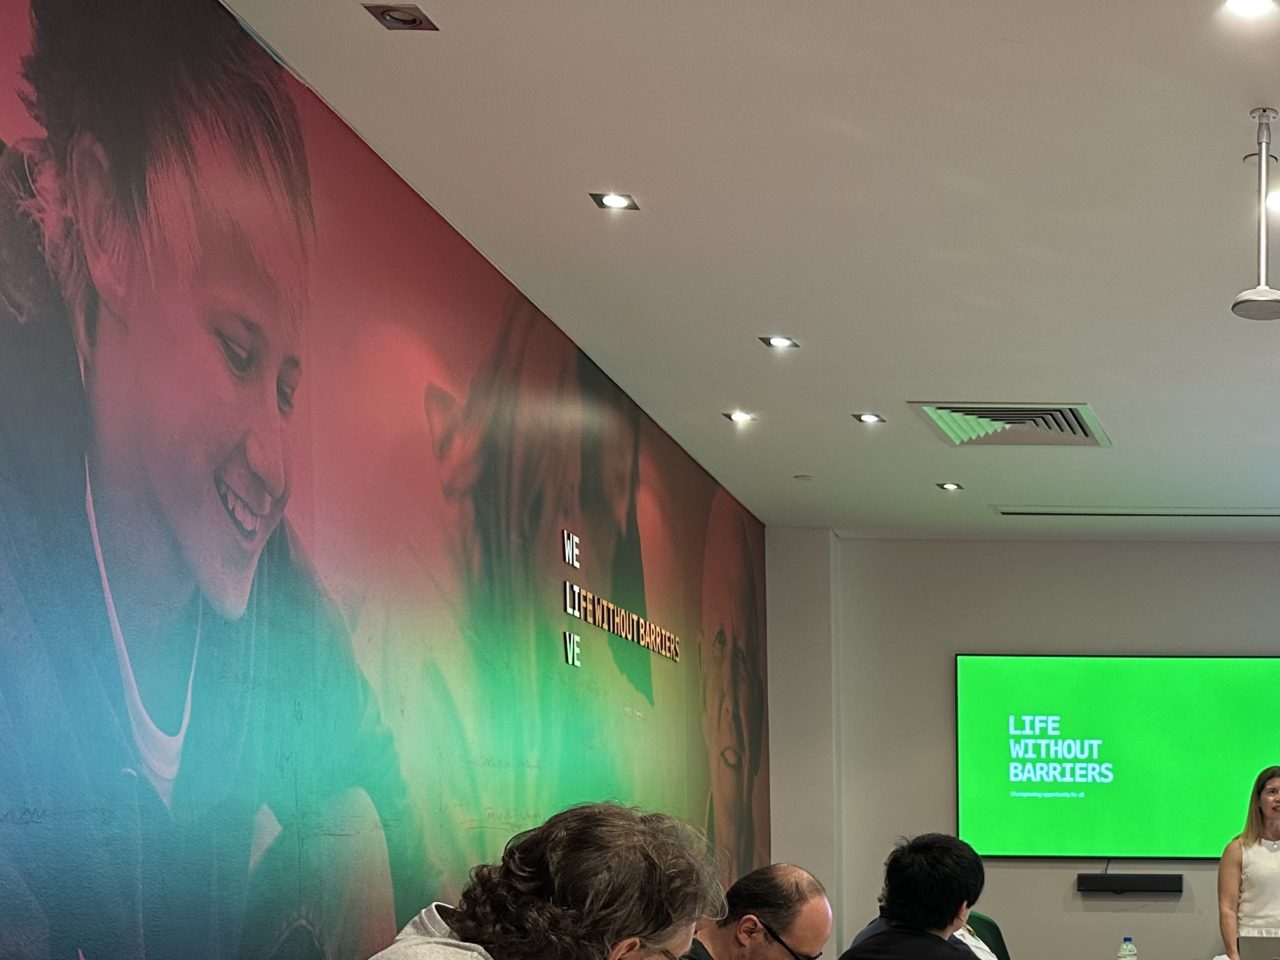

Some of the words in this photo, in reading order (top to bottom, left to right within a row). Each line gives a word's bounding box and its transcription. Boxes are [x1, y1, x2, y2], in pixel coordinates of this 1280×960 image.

[562, 529, 581, 569] WE
[563, 580, 594, 626] LIFE
[593, 597, 639, 643] WITHOUT
[639, 618, 680, 662] BARRIERS
[563, 631, 582, 667] VE
[1008, 715, 1061, 736] LIFE
[1009, 739, 1103, 760] WITHOUT
[1009, 762, 1114, 784] BARRIERS
